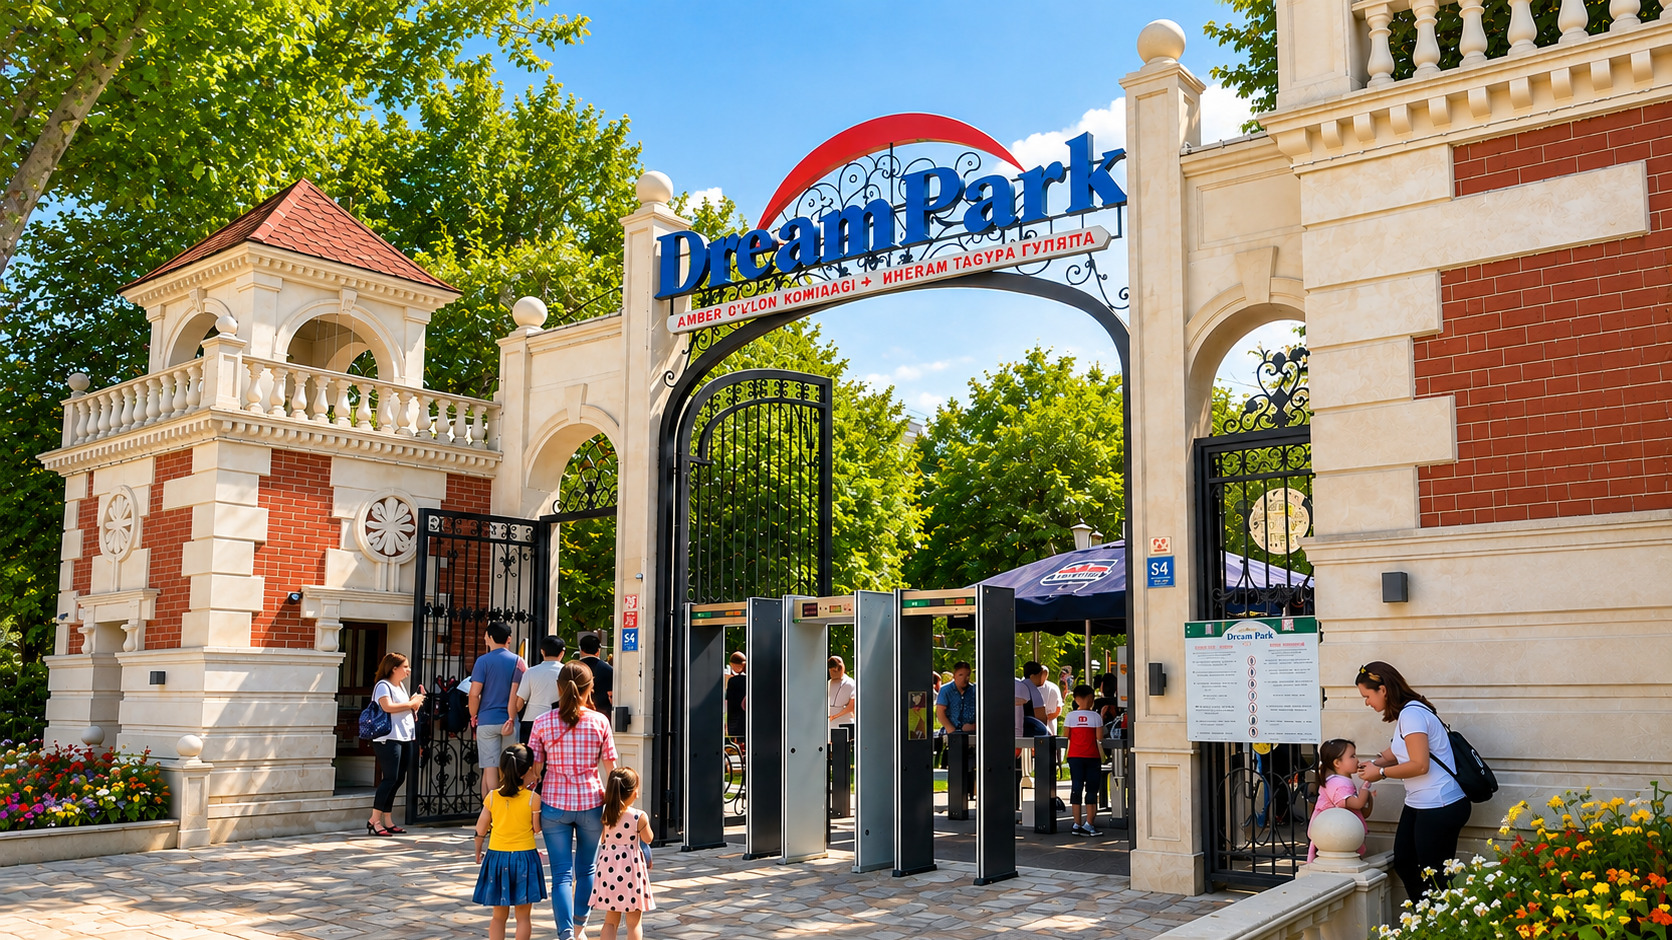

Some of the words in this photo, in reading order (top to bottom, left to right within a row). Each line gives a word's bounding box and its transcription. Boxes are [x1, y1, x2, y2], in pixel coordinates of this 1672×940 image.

[677, 307, 722, 328] AMBER
[1151, 561, 1169, 576] S4
[624, 632, 635, 643] S4
[1227, 633, 1253, 641] Dream
[1254, 631, 1274, 640] Park
